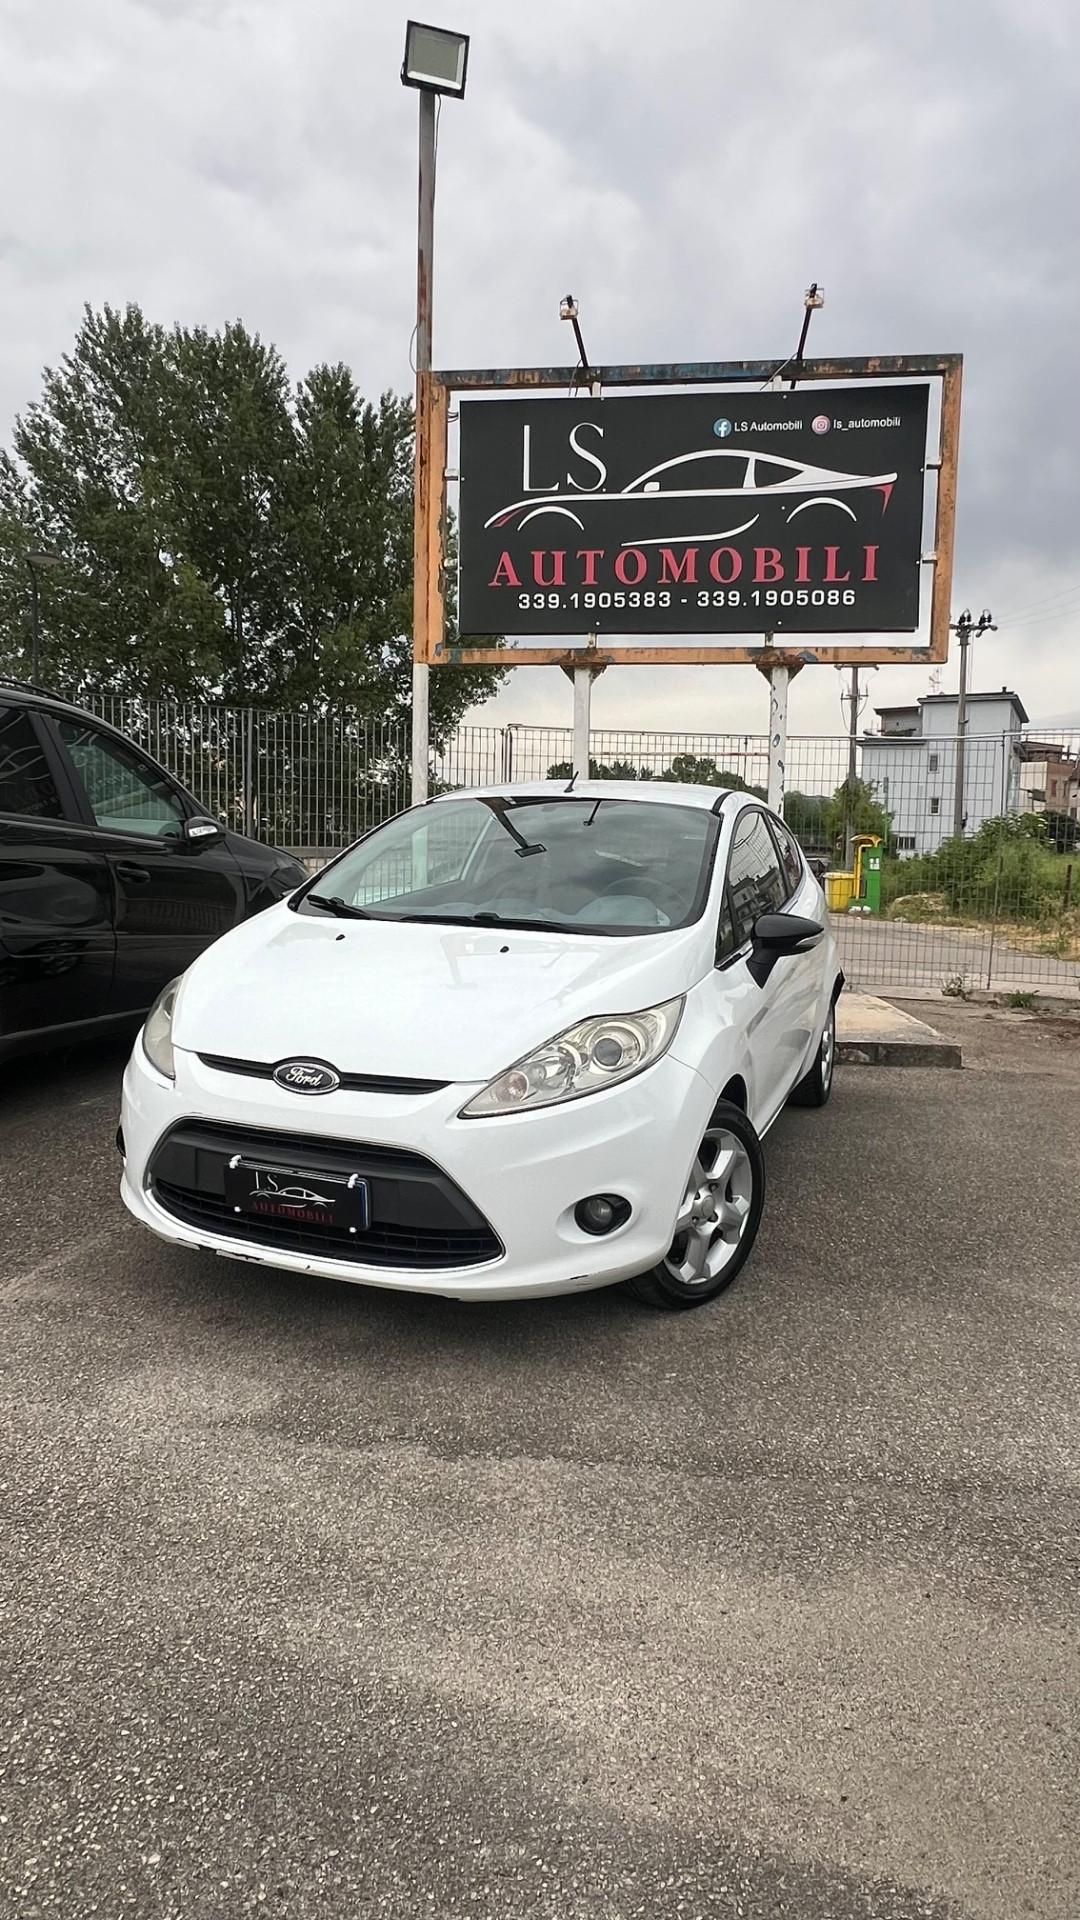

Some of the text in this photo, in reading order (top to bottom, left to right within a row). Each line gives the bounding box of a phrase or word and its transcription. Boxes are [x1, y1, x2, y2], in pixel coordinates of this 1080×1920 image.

[734, 419, 803, 432] LS Automobili
[833, 417, 901, 431] ls_automobili
[522, 421, 607, 492] LS
[488, 545, 880, 587] AUTOMOBILI
[518, 592, 671, 610] 339.1905383
[697, 589, 856, 607] 339.1905086
[285, 1065, 324, 1087] Ford
